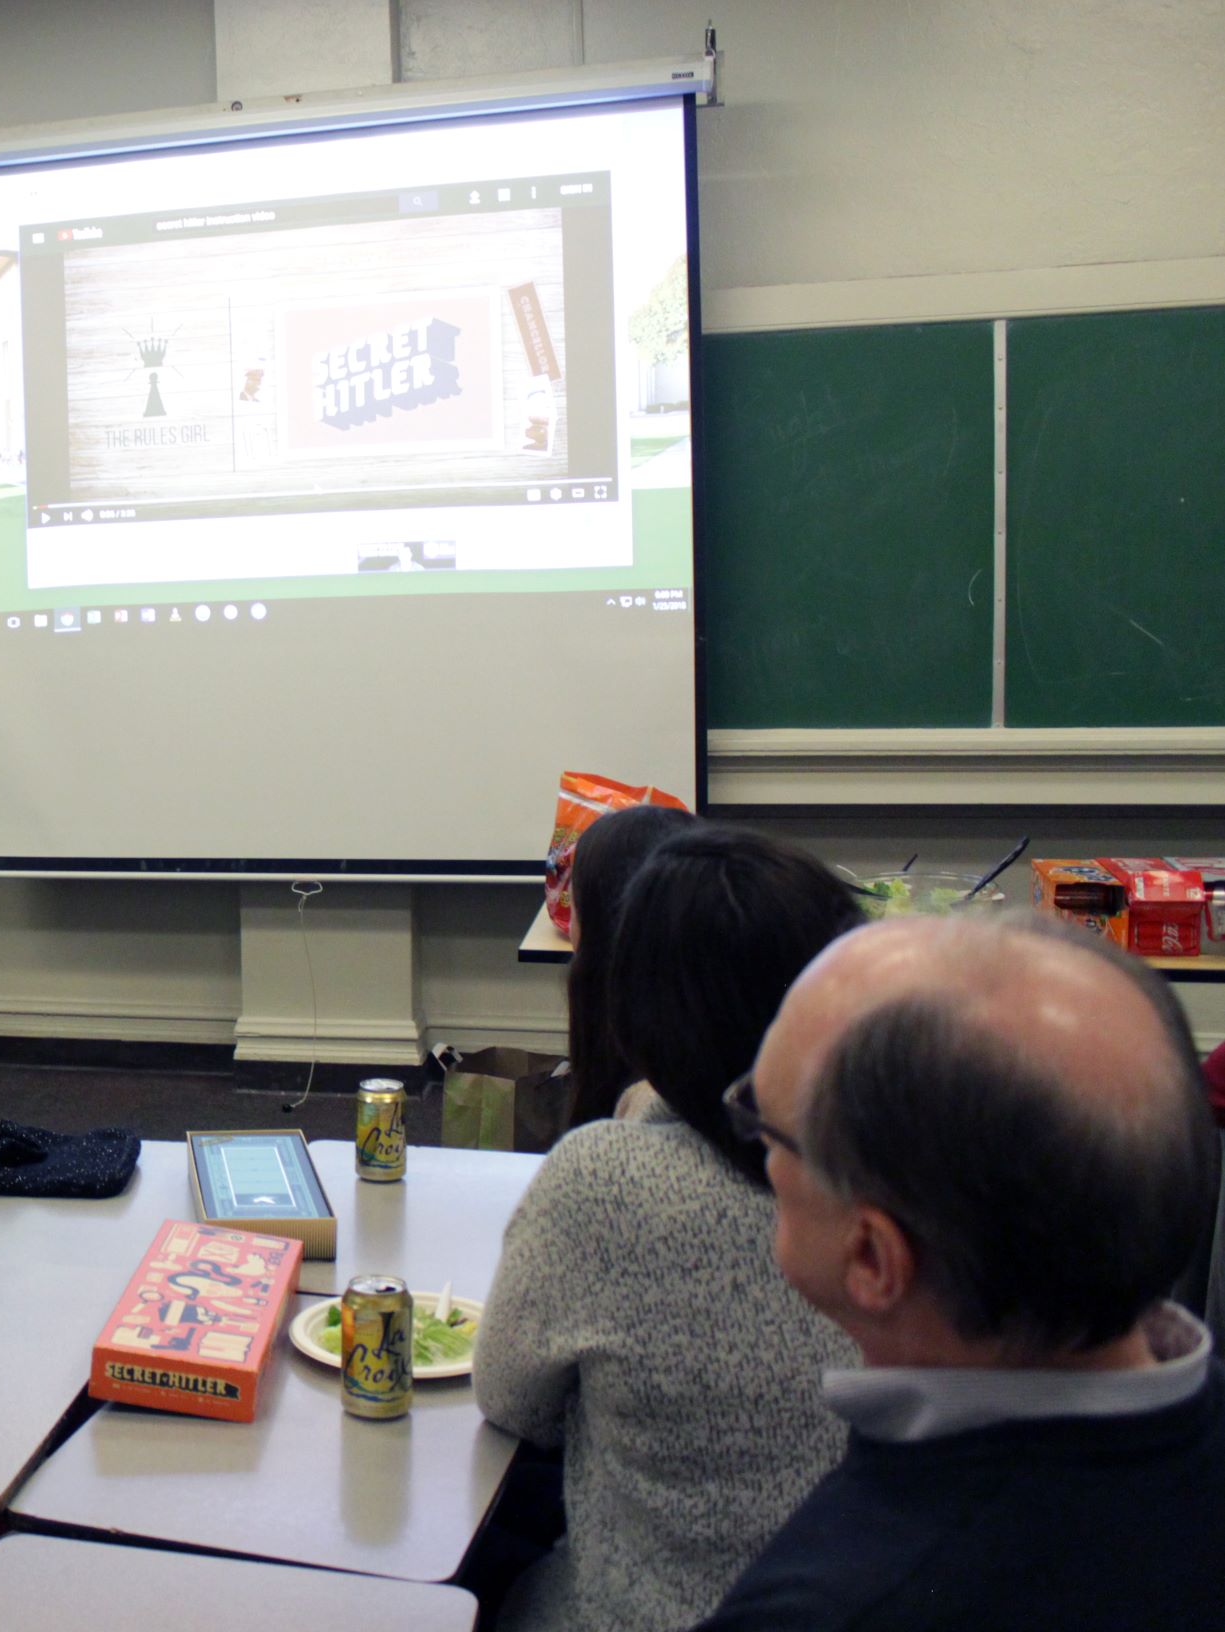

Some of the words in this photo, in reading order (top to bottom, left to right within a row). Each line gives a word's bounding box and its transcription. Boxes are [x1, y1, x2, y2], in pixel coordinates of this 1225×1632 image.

[311, 316, 434, 386] SECRET
[311, 352, 436, 422] HITLER
[105, 428, 131, 449] THE
[134, 425, 177, 448] RULES
[180, 423, 210, 444] GIRL
[104, 1360, 162, 1382] SECRET
[169, 1371, 228, 1396] HITLER
